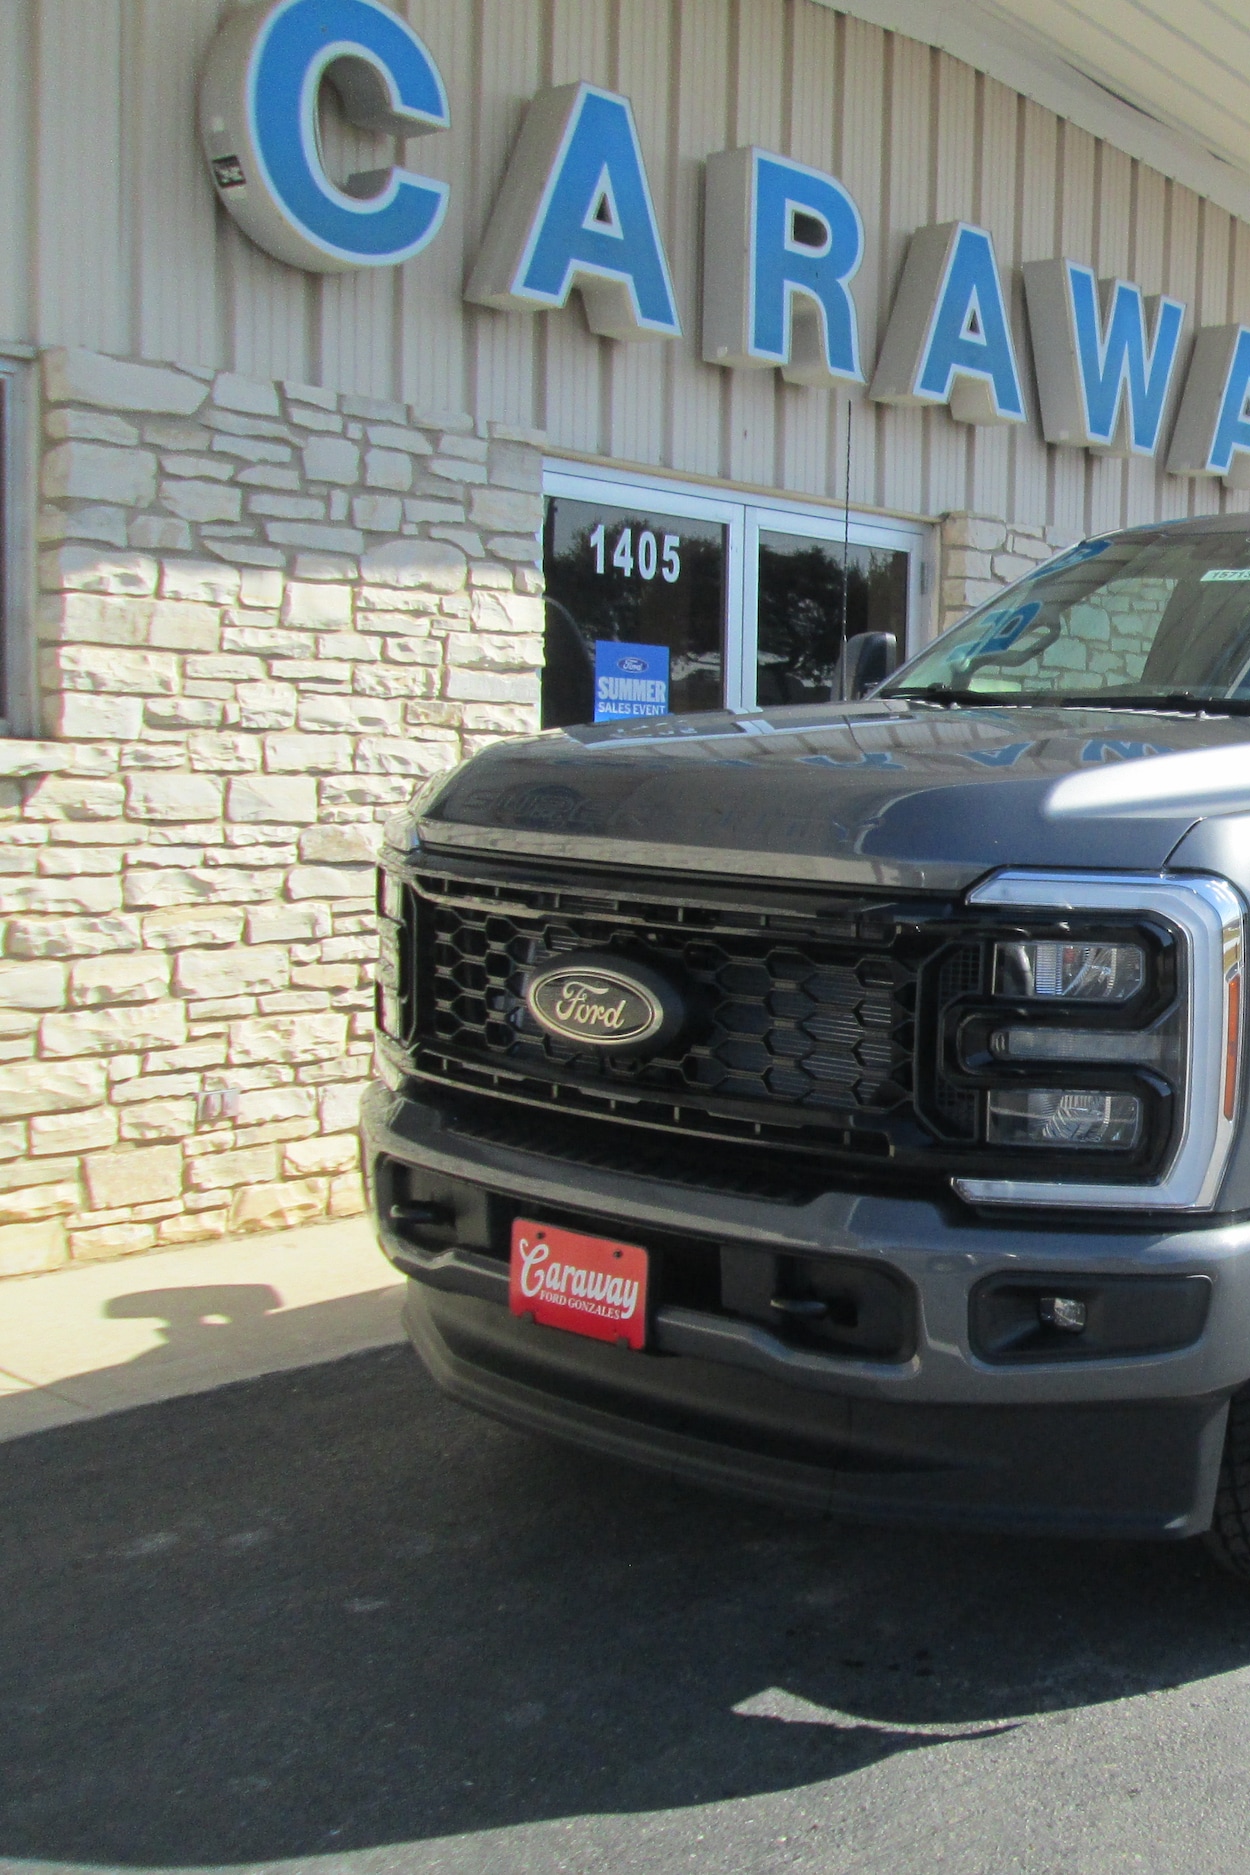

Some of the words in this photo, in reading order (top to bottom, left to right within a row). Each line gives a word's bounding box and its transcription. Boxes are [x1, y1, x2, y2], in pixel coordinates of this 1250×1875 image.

[590, 524, 681, 583] 1405
[622, 659, 644, 671] Ford
[598, 676, 666, 703] SUMMER
[598, 702, 631, 714] SALES
[633, 704, 666, 715] EVENT
[556, 981, 626, 1028] Ford
[519, 1238, 639, 1319] Caraway
[540, 1290, 567, 1306] FORD
[567, 1297, 621, 1320] GONZALES
